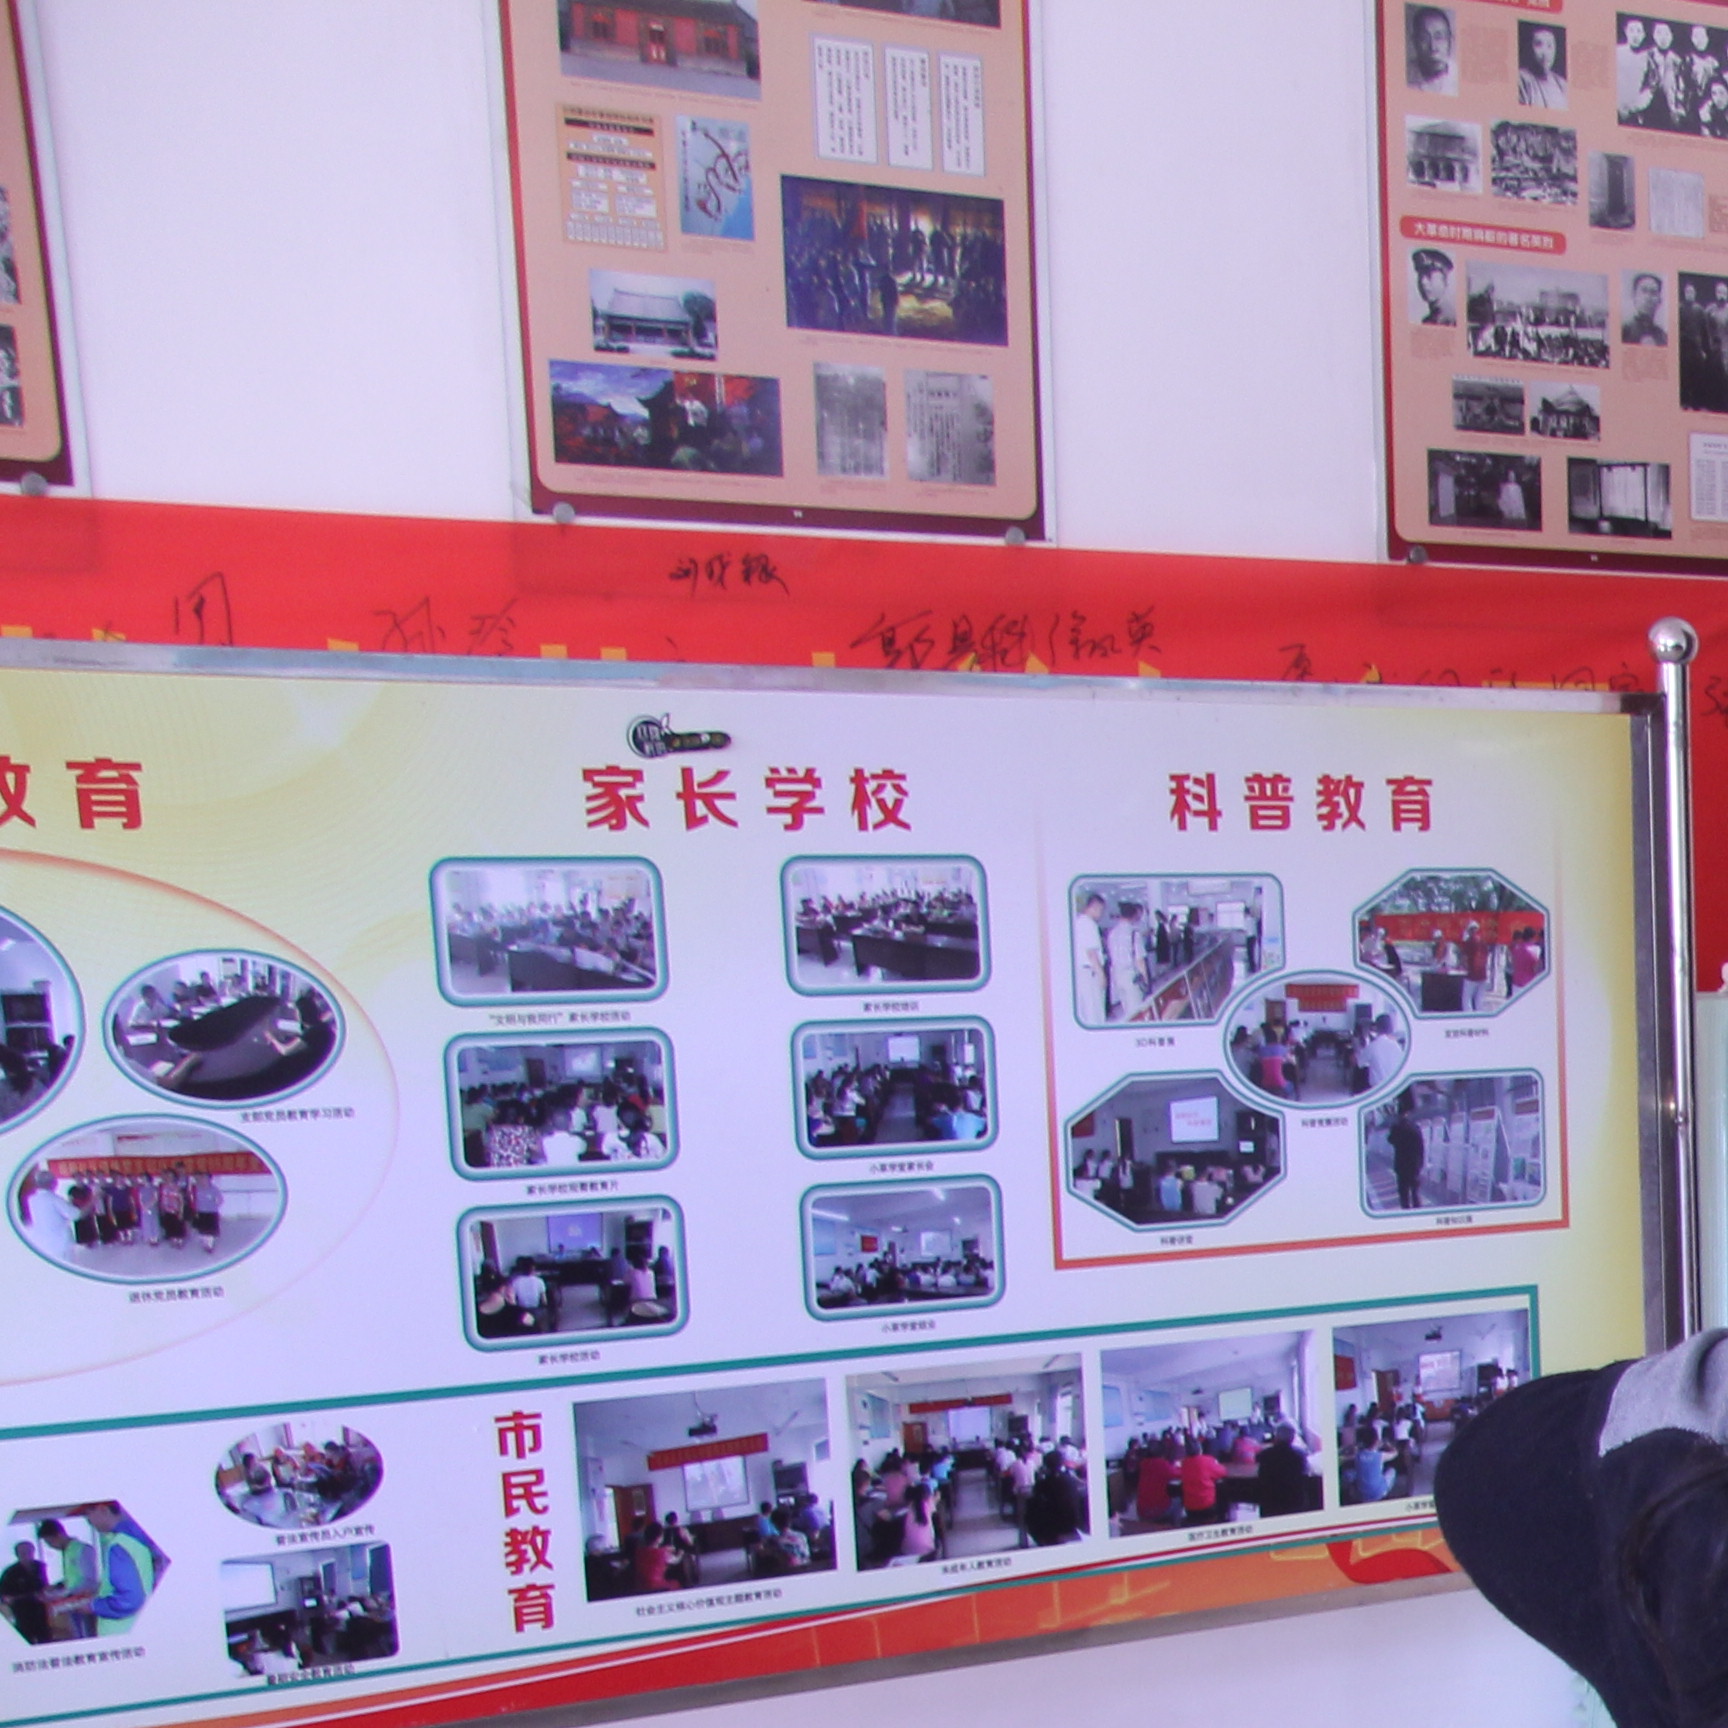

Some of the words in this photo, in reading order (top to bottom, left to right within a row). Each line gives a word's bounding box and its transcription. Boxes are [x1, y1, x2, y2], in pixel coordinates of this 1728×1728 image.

[582, 765, 912, 833] 家长学校
[1169, 772, 1433, 832] 科普教育
[493, 1409, 557, 1635] 市民教育
